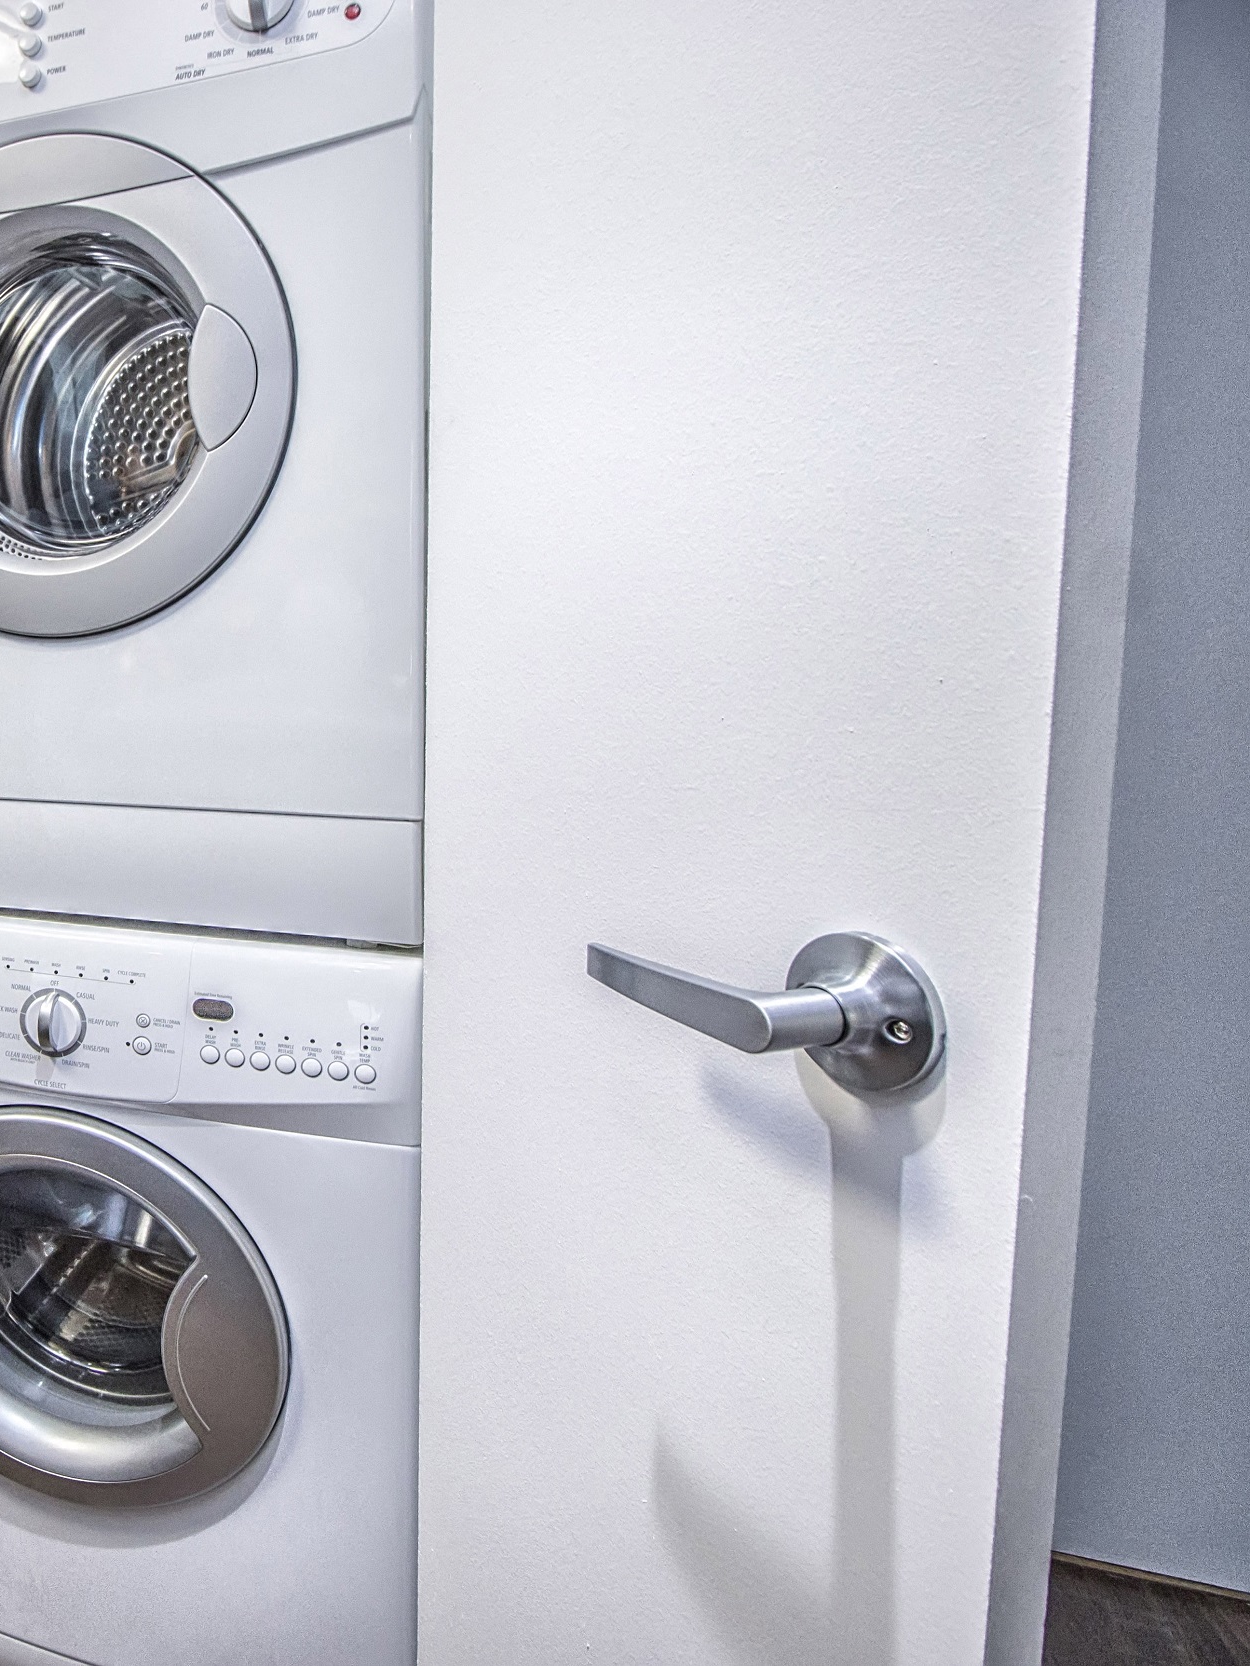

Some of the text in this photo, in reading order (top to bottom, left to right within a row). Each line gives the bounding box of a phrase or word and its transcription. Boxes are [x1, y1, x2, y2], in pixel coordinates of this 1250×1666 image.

[48, 3, 64, 13] START
[200, 3, 208, 11] 60
[307, 5, 340, 19] DAMP DRY
[47, 28, 86, 42] TEMPERATURE
[184, 30, 215, 42] DAMP DRY
[285, 32, 318, 45] EXTRA DRY
[207, 48, 235, 59] IRON DRY
[247, 46, 274, 58] NORMAL
[47, 65, 66, 75] POWER
[175, 69, 206, 81] AUTO DRY
[11, 984, 31, 992] NORMAL
[76, 992, 95, 1000] CASUAL
[88, 1018, 119, 1028] HEAVY DUTY
[0, 1032, 21, 1040] DELICATE
[83, 1044, 110, 1053] RINSE/SPIN
[5, 1050, 41, 1062] CLEAN WASHER
[61, 1059, 90, 1069] DRAIN/SPIN
[34, 1079, 66, 1089] CYCLE SELECT
